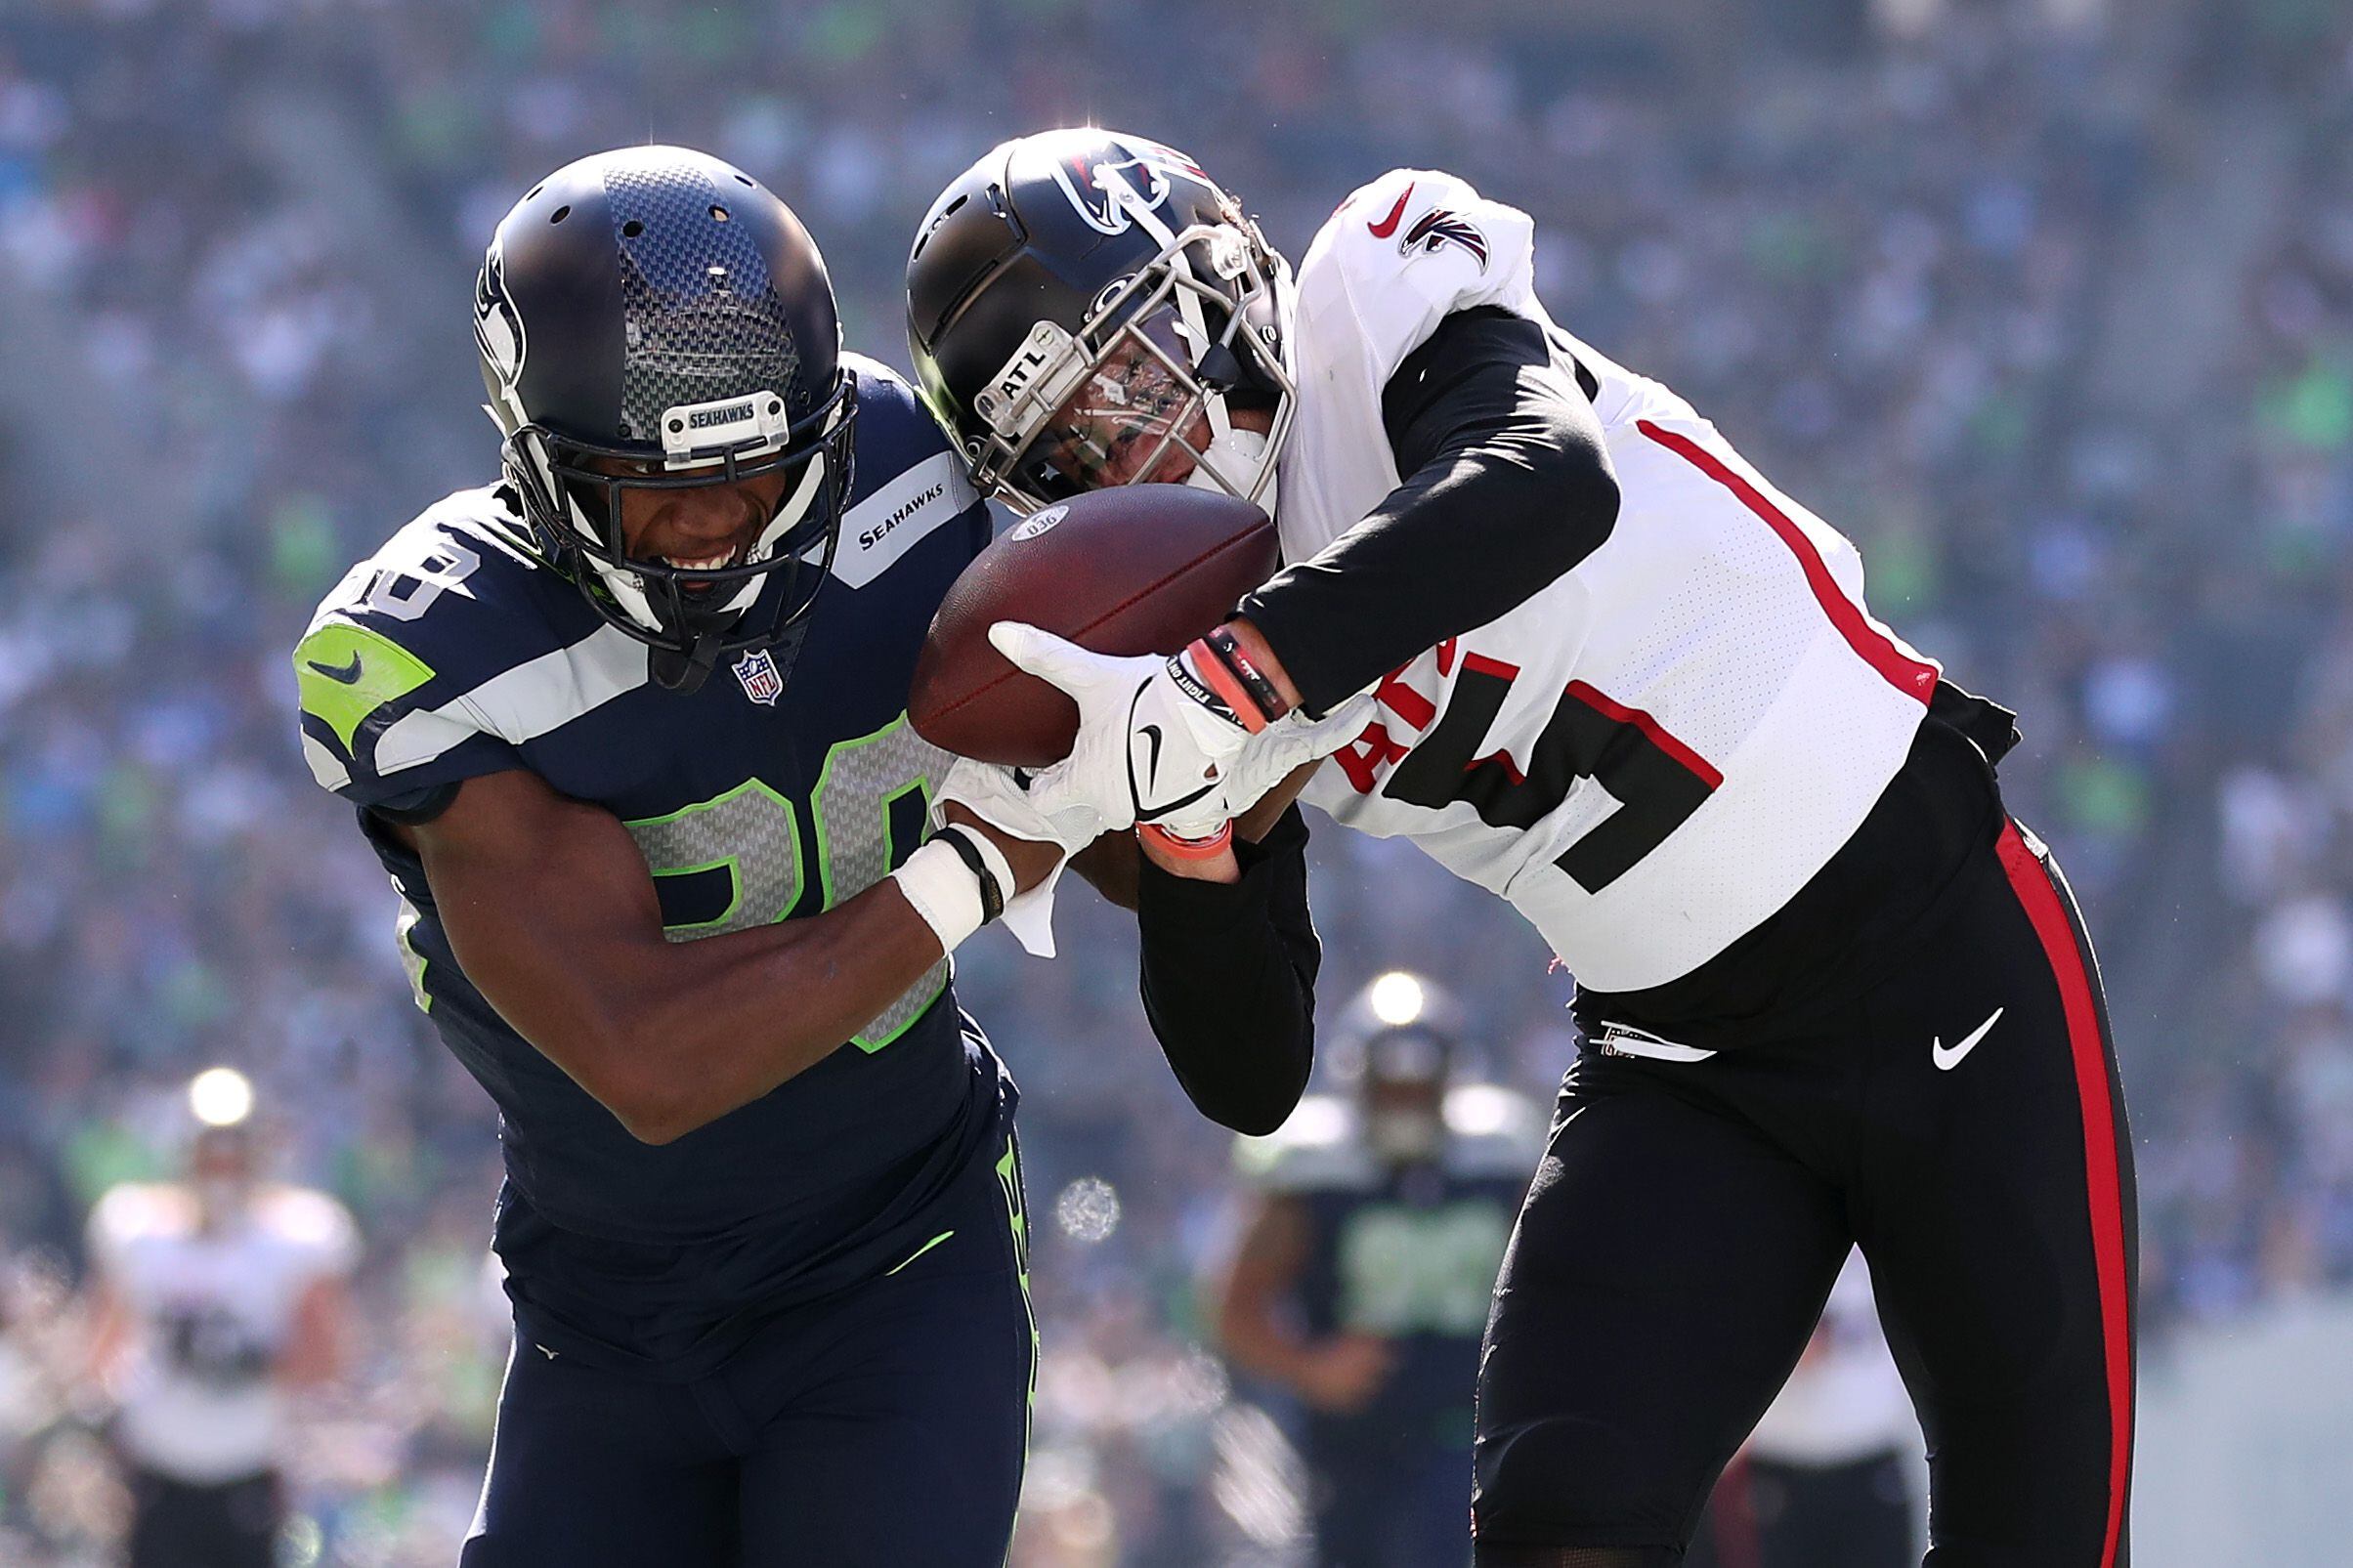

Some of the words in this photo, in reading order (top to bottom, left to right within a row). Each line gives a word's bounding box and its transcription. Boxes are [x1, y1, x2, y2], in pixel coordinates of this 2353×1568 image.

[1001, 352, 1047, 400] ATL
[690, 403, 753, 428] SEAHAWKS
[859, 484, 943, 551] SEAHAWKS
[1176, 675, 1211, 704] FIGHT
